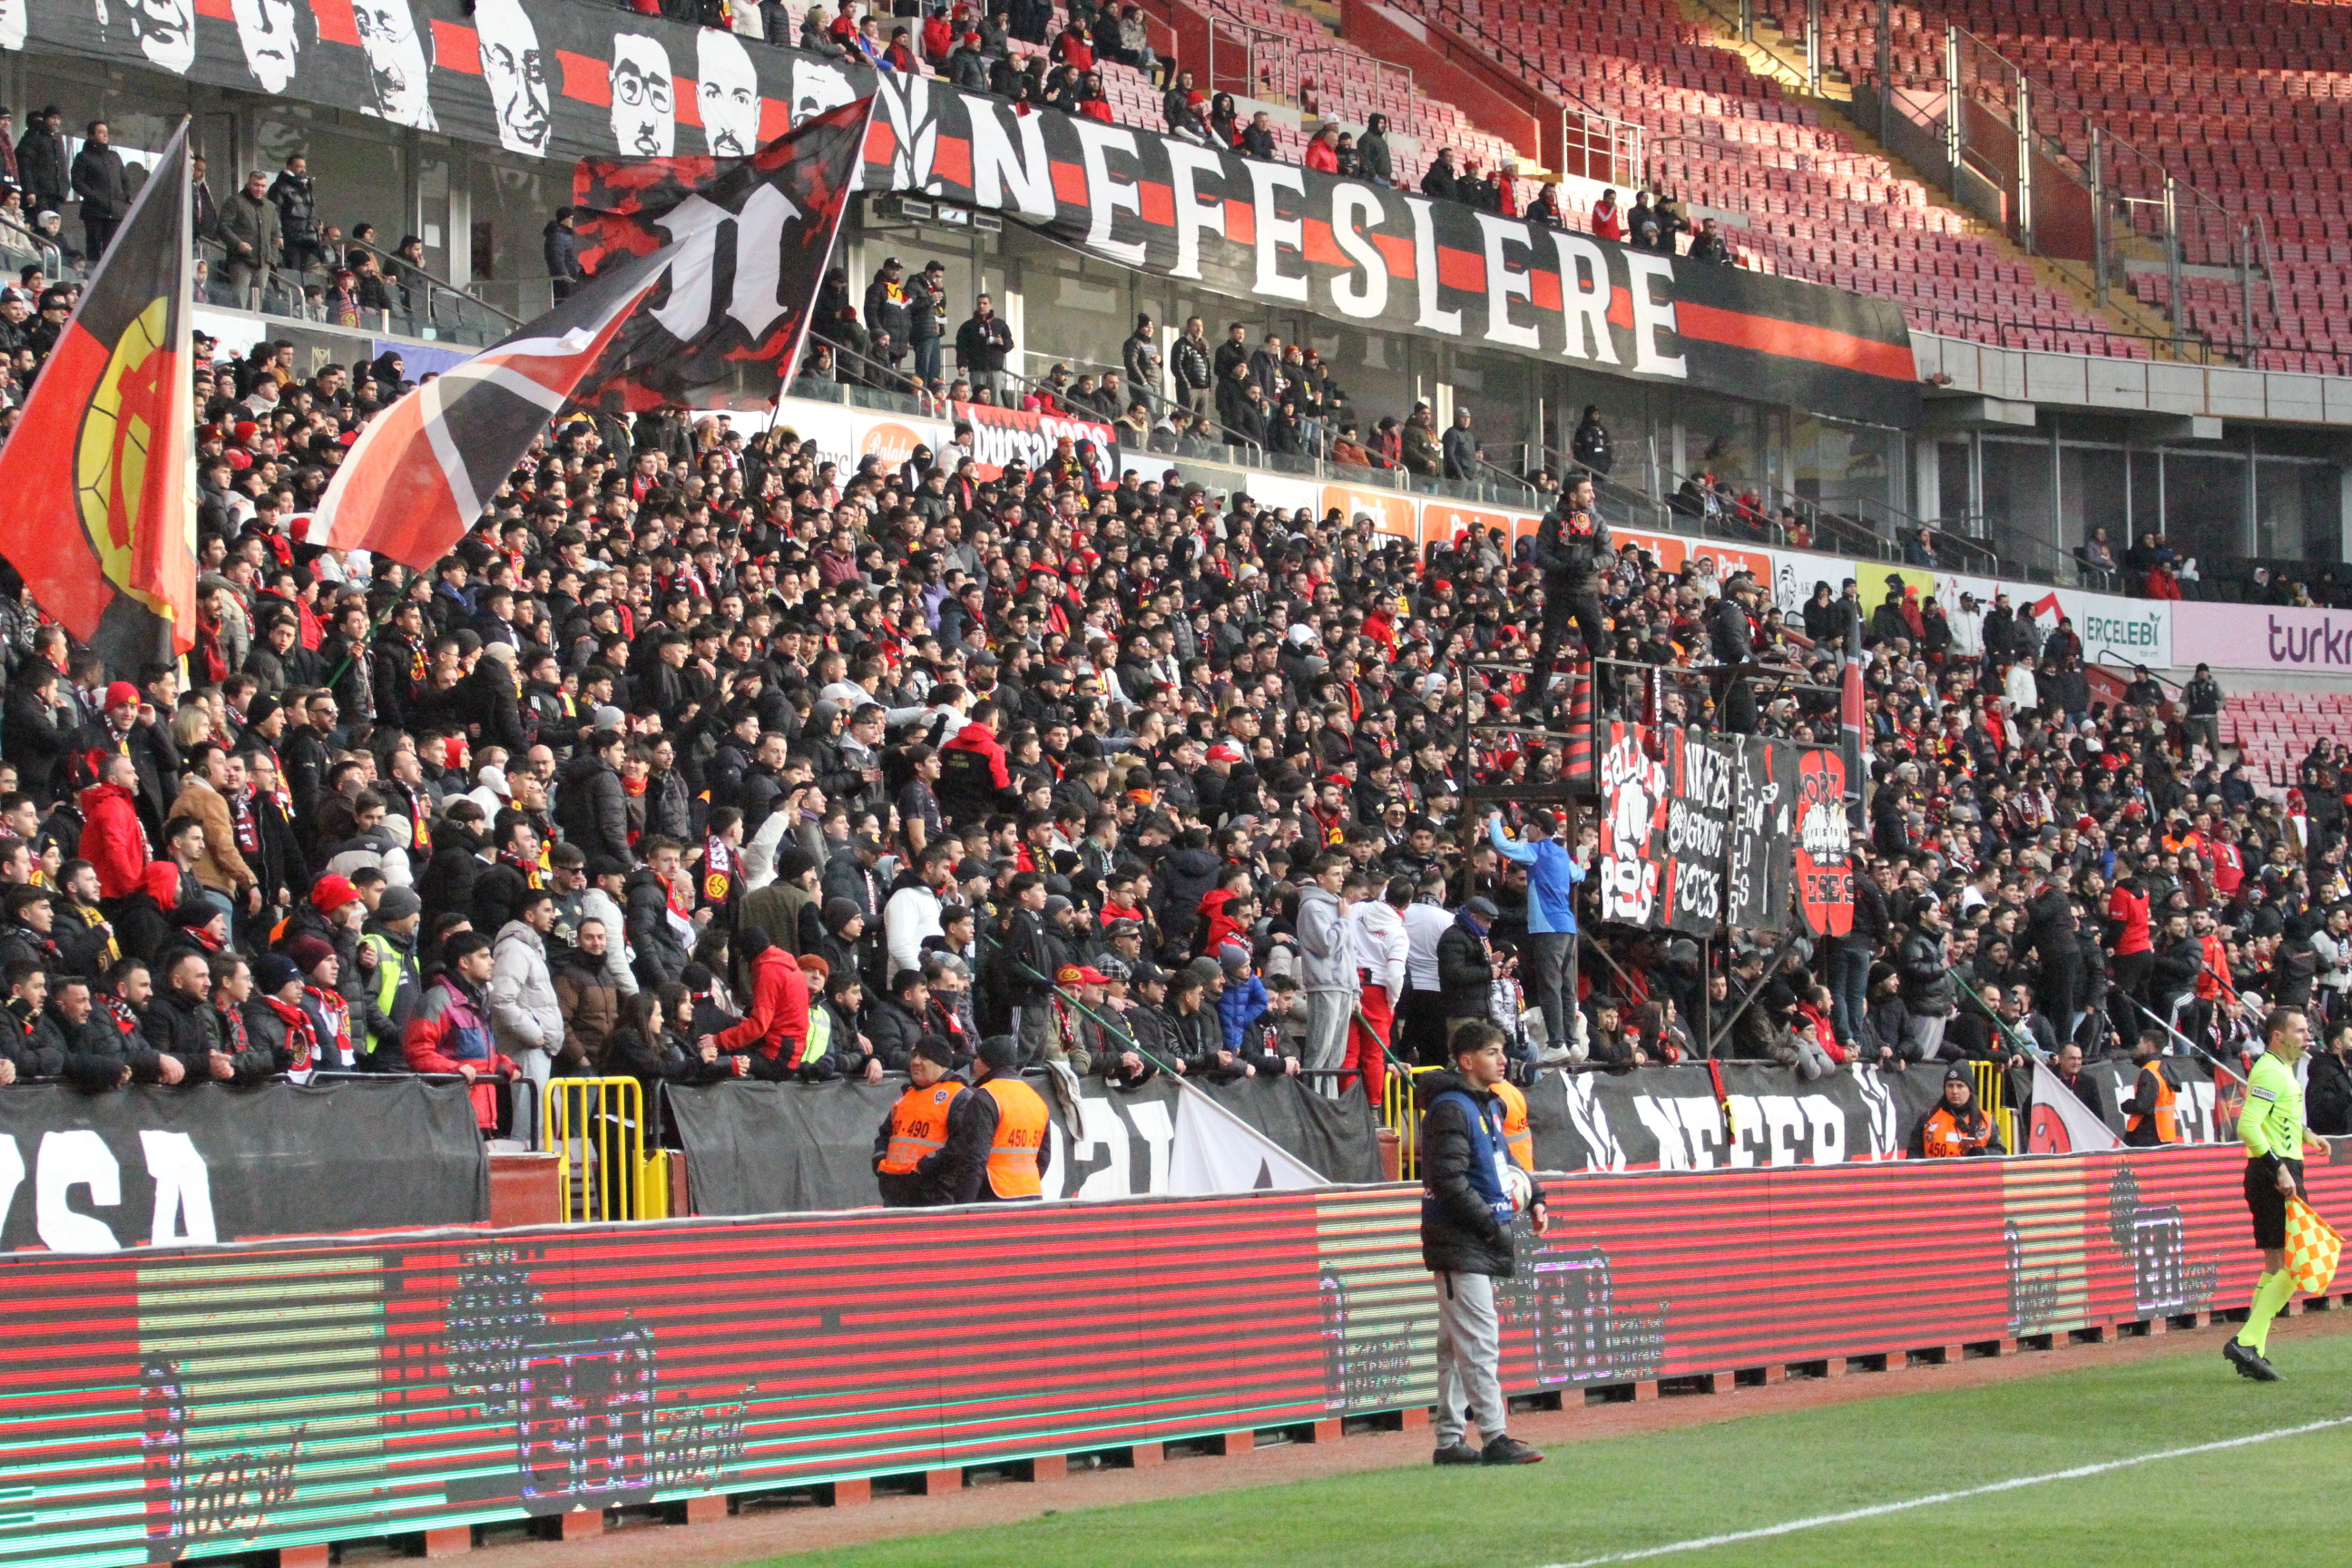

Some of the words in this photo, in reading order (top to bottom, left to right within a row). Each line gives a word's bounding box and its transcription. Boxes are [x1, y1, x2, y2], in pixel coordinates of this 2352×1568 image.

[958, 93, 1689, 379] NEFESLERE
[907, 1121, 929, 1139] 490
[1008, 1129, 1027, 1147] 450
[1928, 1143, 1946, 1158] 450
